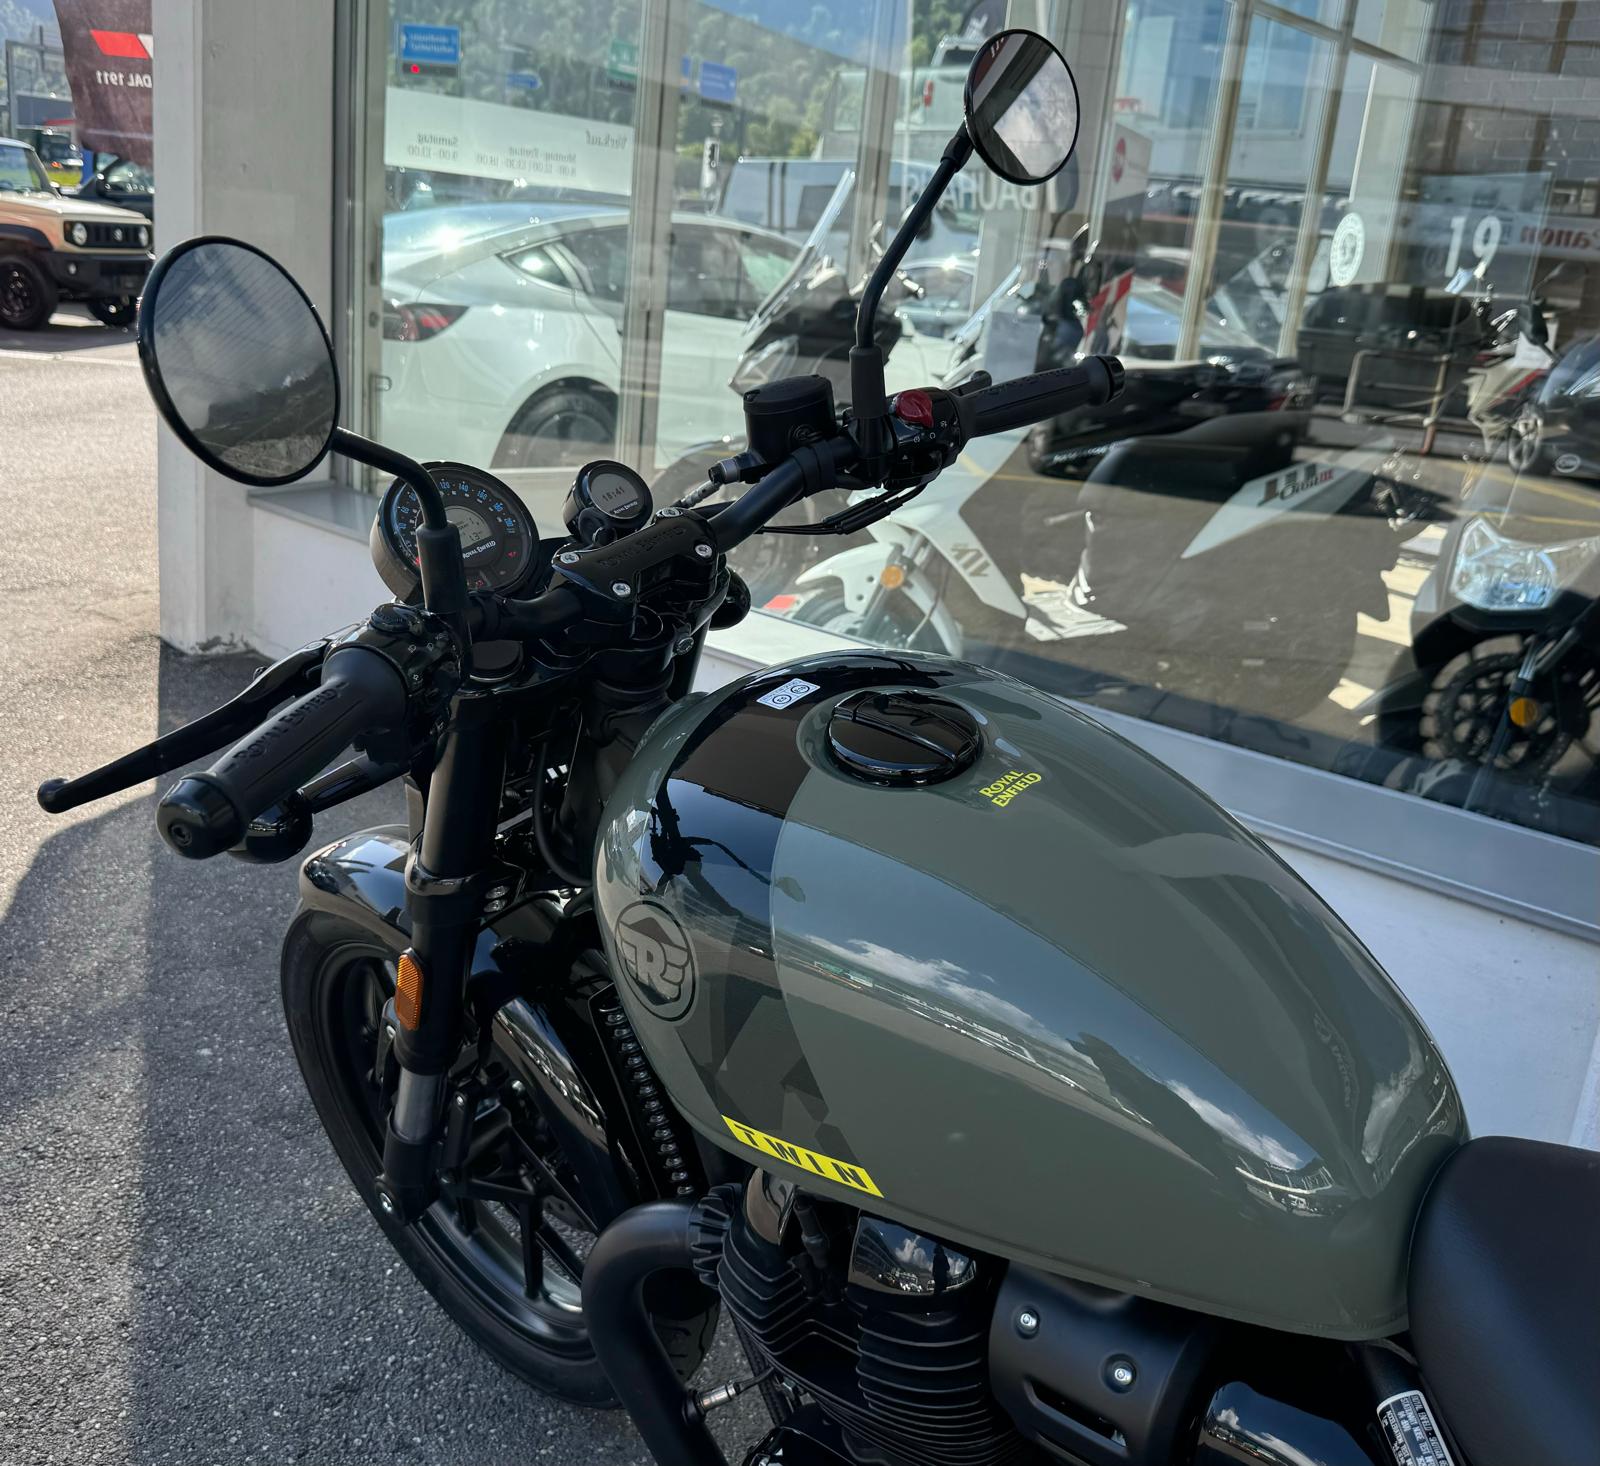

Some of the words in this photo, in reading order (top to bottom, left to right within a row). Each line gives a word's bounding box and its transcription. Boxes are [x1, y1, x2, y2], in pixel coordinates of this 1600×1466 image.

[979, 769, 1025, 798] ROYAL
[992, 772, 1042, 807] ENFIELD
[734, 1122, 868, 1190] TWIN
